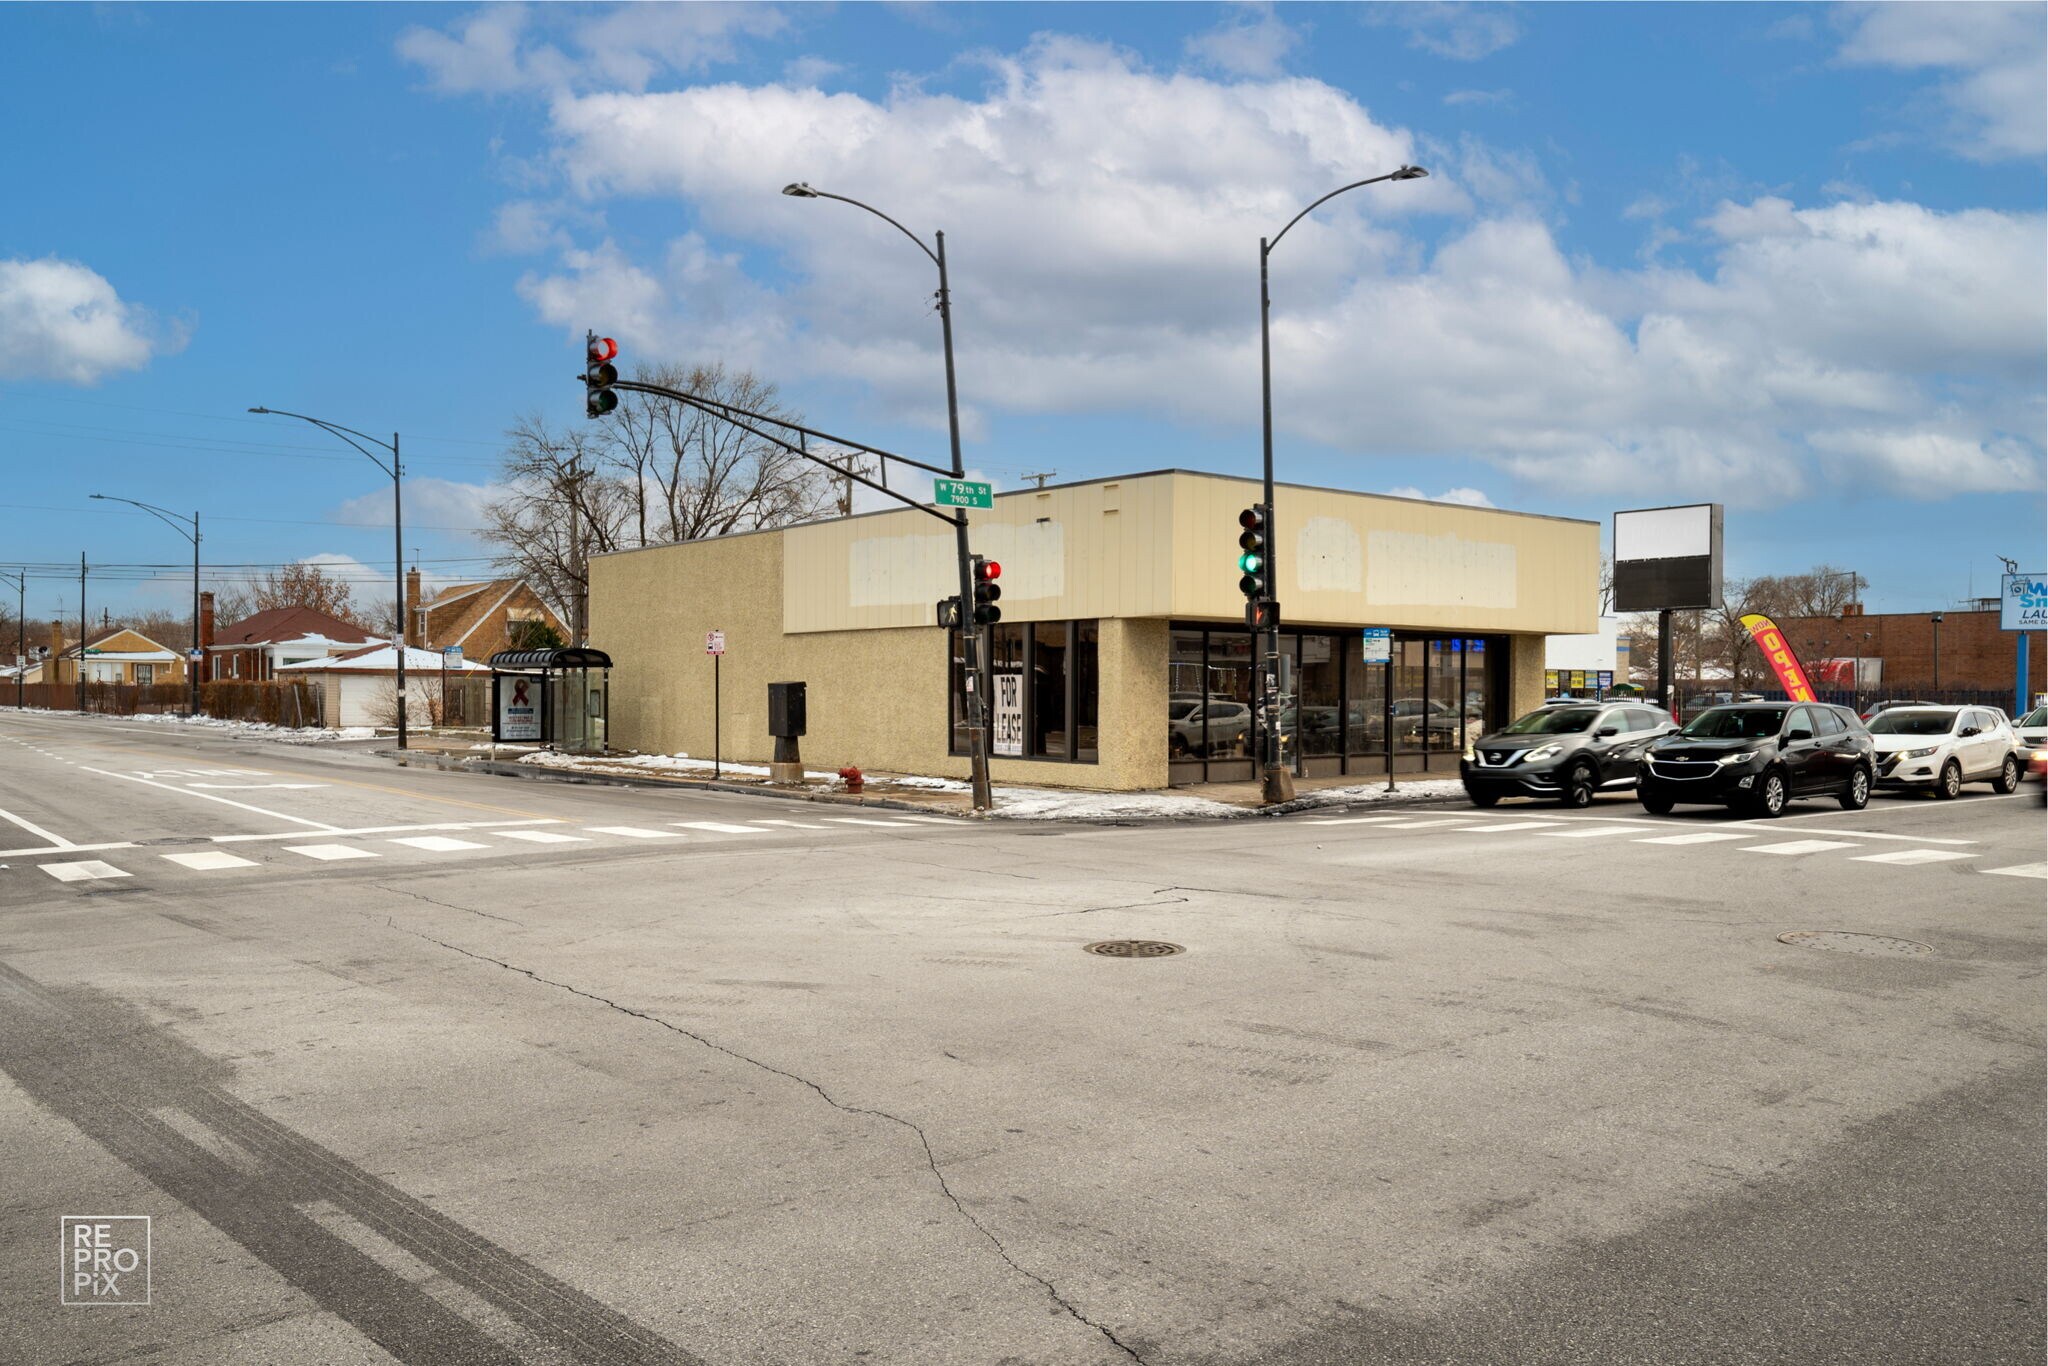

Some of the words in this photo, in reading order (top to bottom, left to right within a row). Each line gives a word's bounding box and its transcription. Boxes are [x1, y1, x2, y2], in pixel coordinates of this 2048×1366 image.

[939, 482, 947, 491] W
[949, 482, 974, 495] 79th
[978, 486, 987, 495] St
[950, 494, 969, 504] 7900
[972, 497, 978, 505] S
[1000, 676, 1017, 707] FOR
[996, 713, 1022, 744] LEASE
